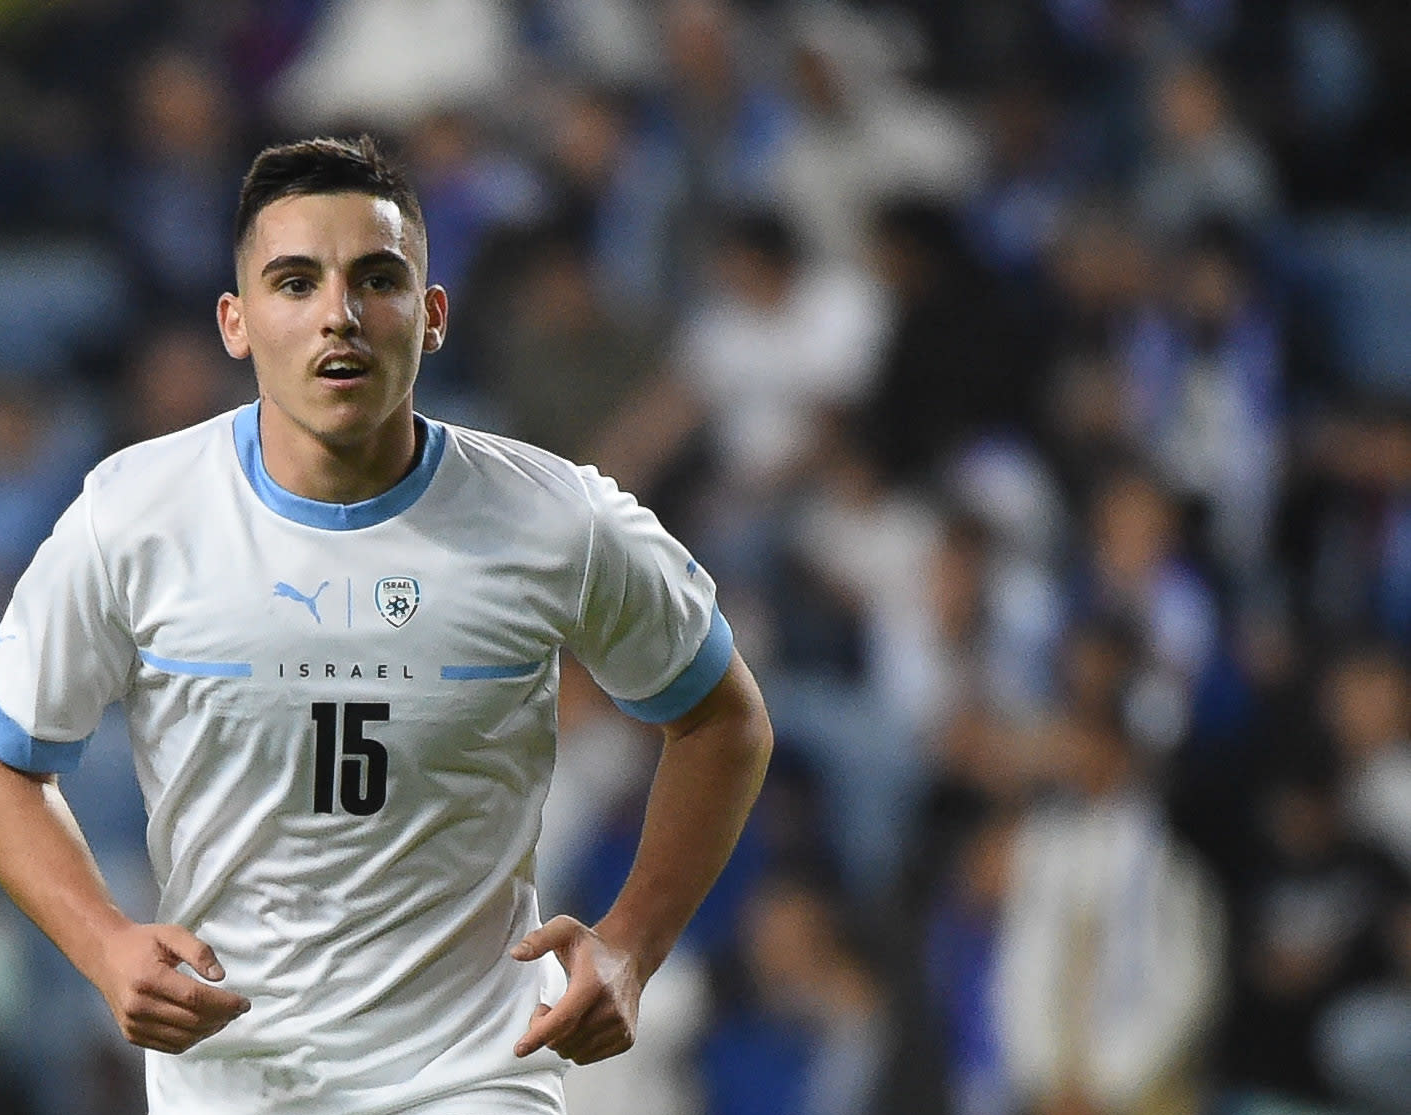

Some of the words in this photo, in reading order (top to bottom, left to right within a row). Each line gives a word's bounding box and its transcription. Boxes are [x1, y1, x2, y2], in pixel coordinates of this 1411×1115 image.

[383, 581, 412, 590] ISRAEL
[279, 663, 414, 679] ISRAEL
[312, 702, 391, 817] 15
